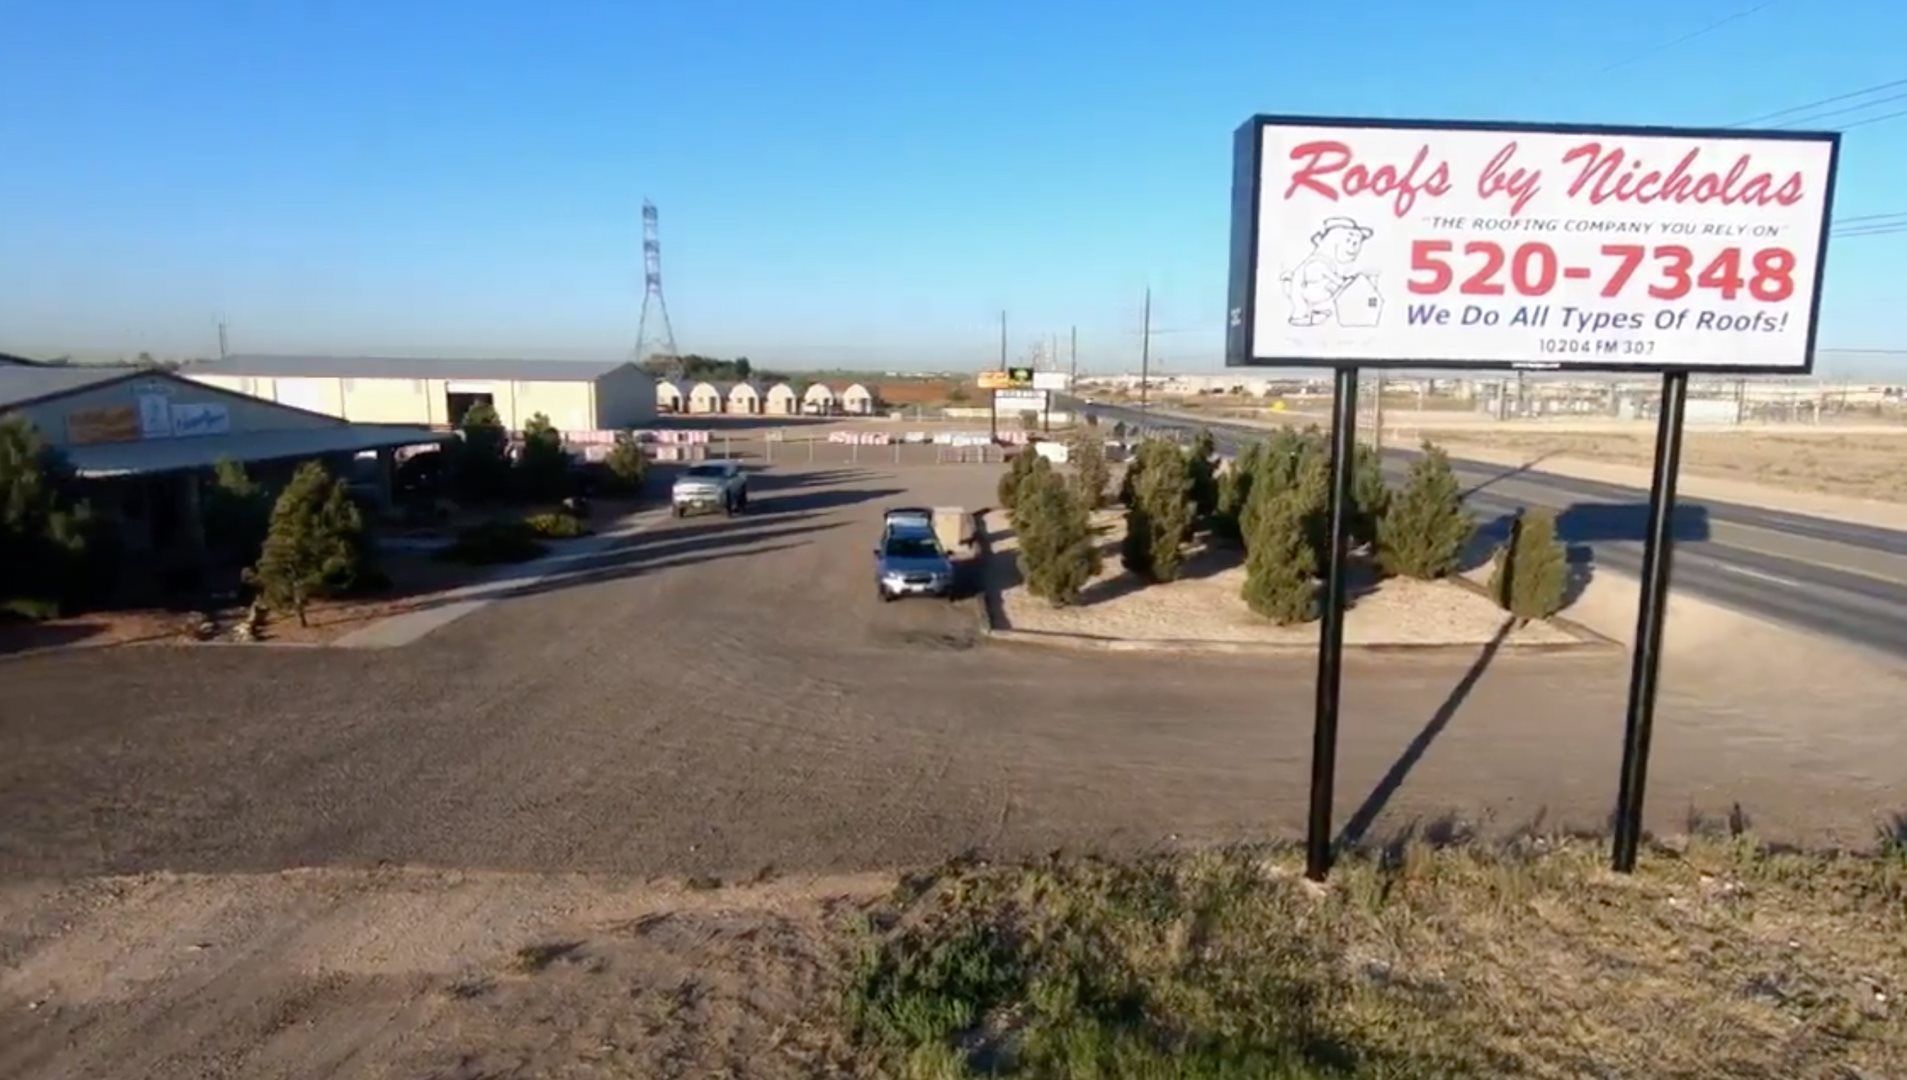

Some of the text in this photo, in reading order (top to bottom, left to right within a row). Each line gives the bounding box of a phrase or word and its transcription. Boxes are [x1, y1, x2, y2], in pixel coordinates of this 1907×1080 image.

[1283, 139, 1805, 219] Roofs by Nicholas
[1471, 217, 1558, 232] ROOFING
[1563, 219, 1654, 234] COMPANY
[1659, 222, 1697, 235] YOU
[1702, 223, 1748, 236] RELY
[1406, 239, 1798, 304] 520-7348
[1407, 303, 1790, 334] We Do All Types Of Roofs!
[1538, 338, 1656, 355] 10204 FM 307
